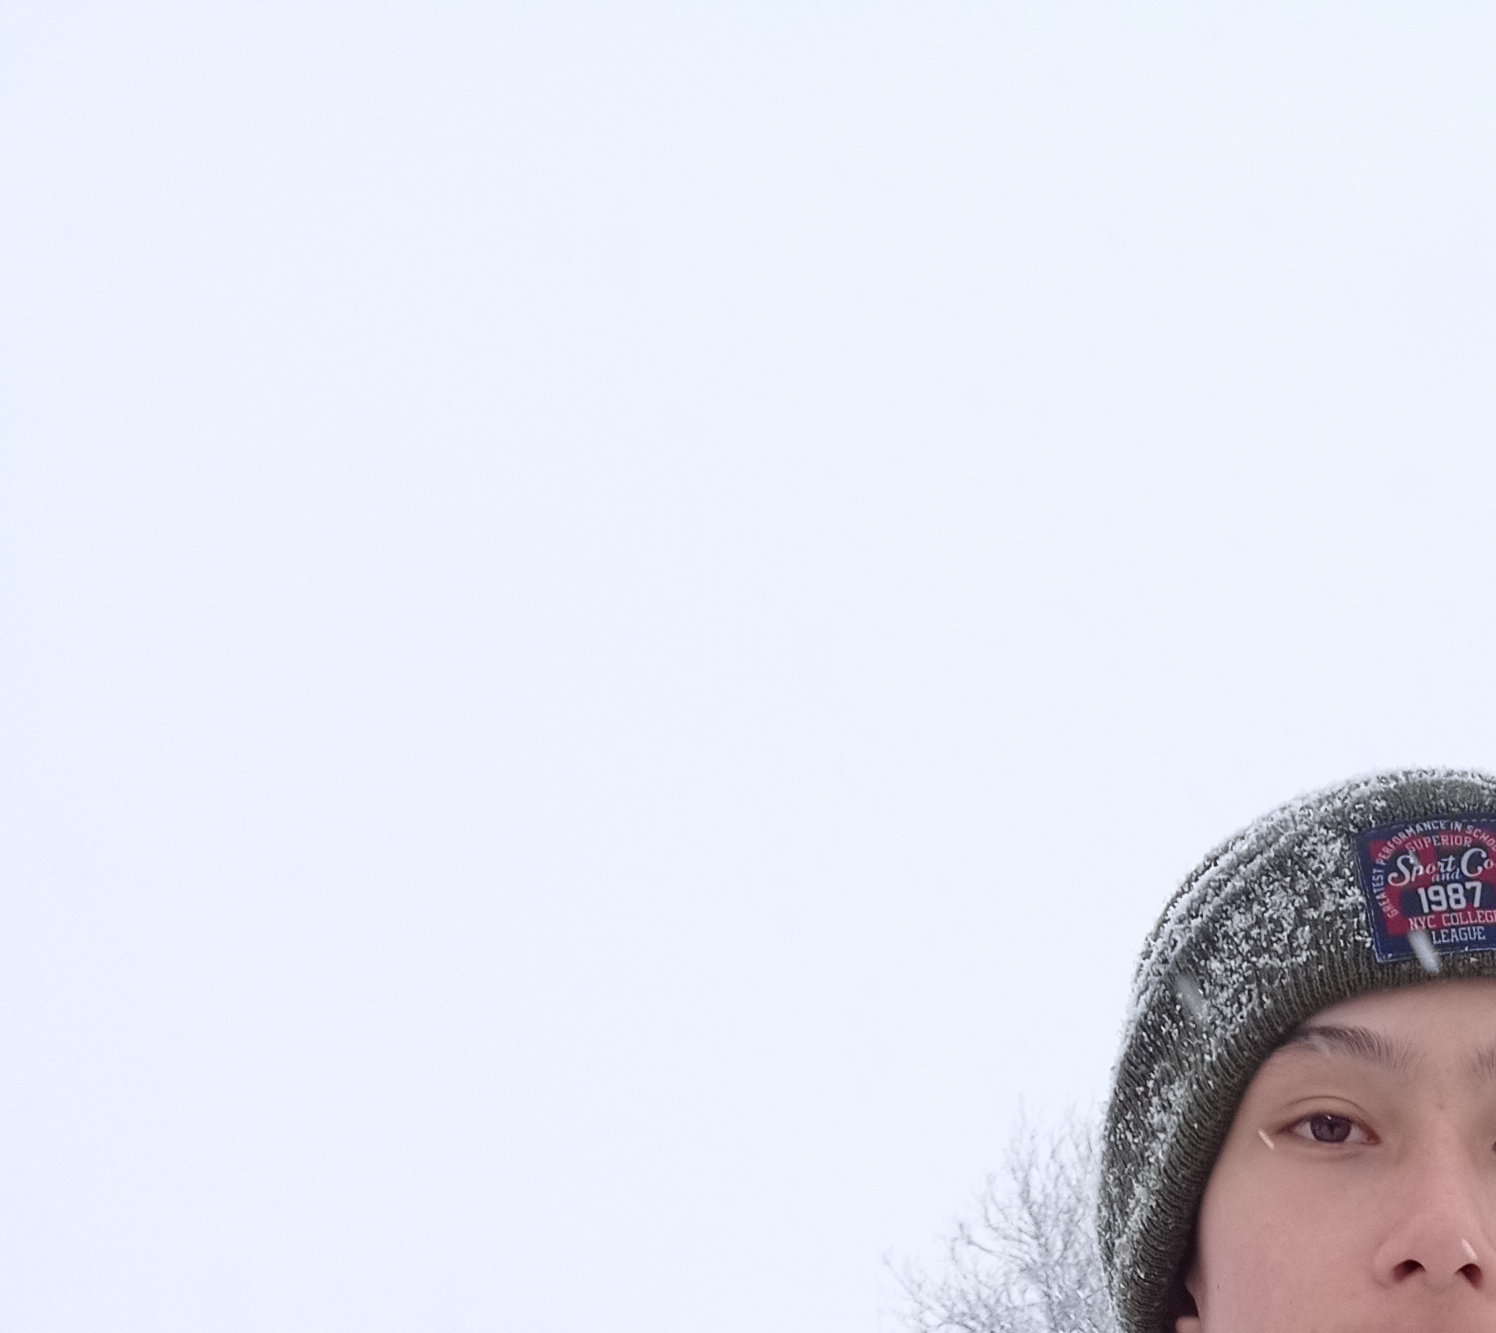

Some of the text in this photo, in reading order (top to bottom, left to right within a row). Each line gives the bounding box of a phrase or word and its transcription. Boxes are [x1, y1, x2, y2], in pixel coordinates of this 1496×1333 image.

[1450, 821, 1463, 833] IN
[1376, 820, 1446, 867] PERFORMANCE
[1405, 834, 1472, 852] SUPERIOR
[1387, 854, 1456, 887] Sport
[1432, 868, 1461, 883] and
[1371, 868, 1399, 919] GREATEST
[1417, 881, 1482, 914] 1987
[1408, 914, 1437, 931] NYC
[1431, 926, 1487, 945] LEAGUE
